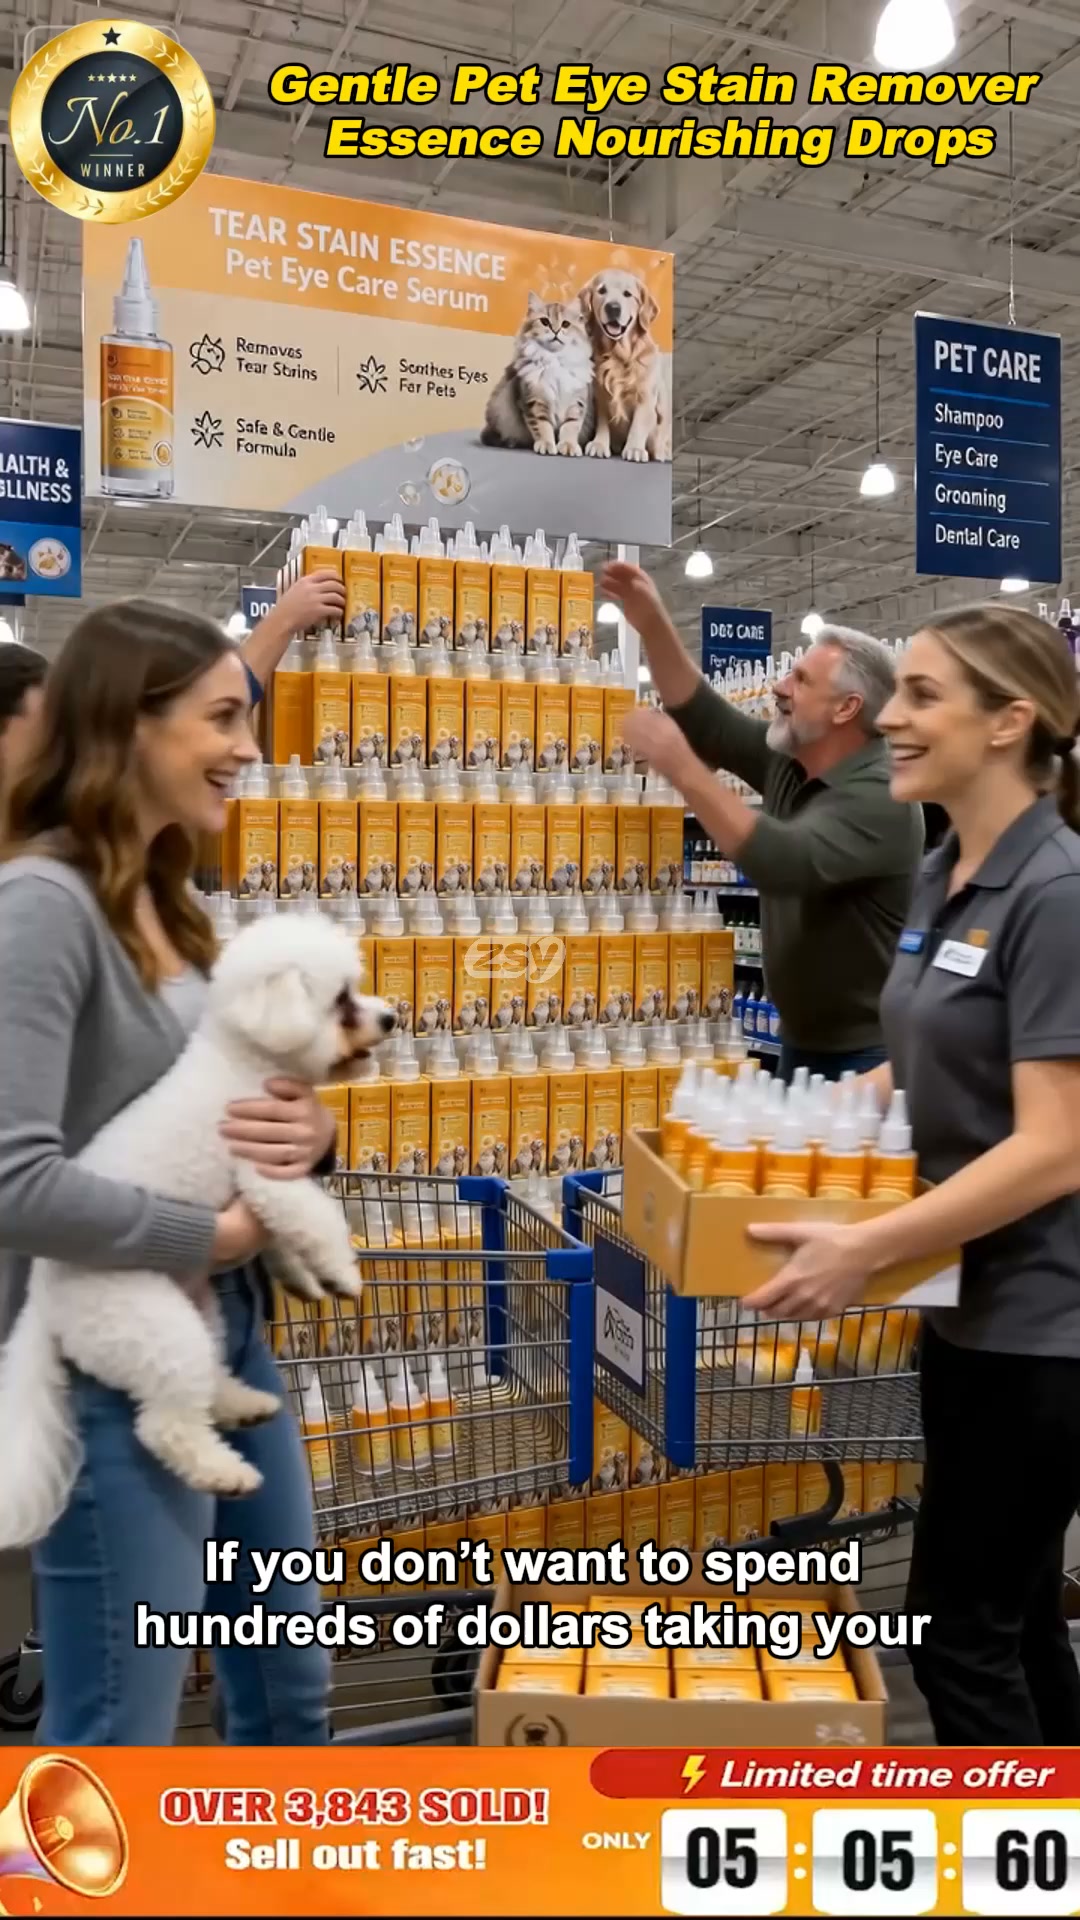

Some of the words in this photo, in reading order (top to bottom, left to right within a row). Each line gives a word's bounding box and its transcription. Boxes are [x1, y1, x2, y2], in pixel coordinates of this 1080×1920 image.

[208, 207, 287, 246] TEAR
[297, 221, 380, 261] STAIN
[390, 238, 507, 281] ESSENCE
[226, 248, 272, 280] Pet
[281, 257, 329, 291] Eye
[337, 266, 398, 299] Care
[407, 278, 489, 312] Serum
[237, 358, 267, 374] Tear
[934, 339, 977, 374] PET
[983, 347, 1041, 384] CARE
[458, 366, 489, 384] Eyes
[427, 381, 457, 398] Pets
[273, 422, 284, 437] &
[935, 403, 1004, 432] Shampoo
[236, 438, 297, 458] Formula
[935, 443, 962, 468] Eye
[965, 447, 999, 468] Care
[55, 458, 69, 478] &
[935, 483, 1007, 513] Grooming
[935, 524, 982, 547] Dental
[987, 529, 1020, 549] Care
